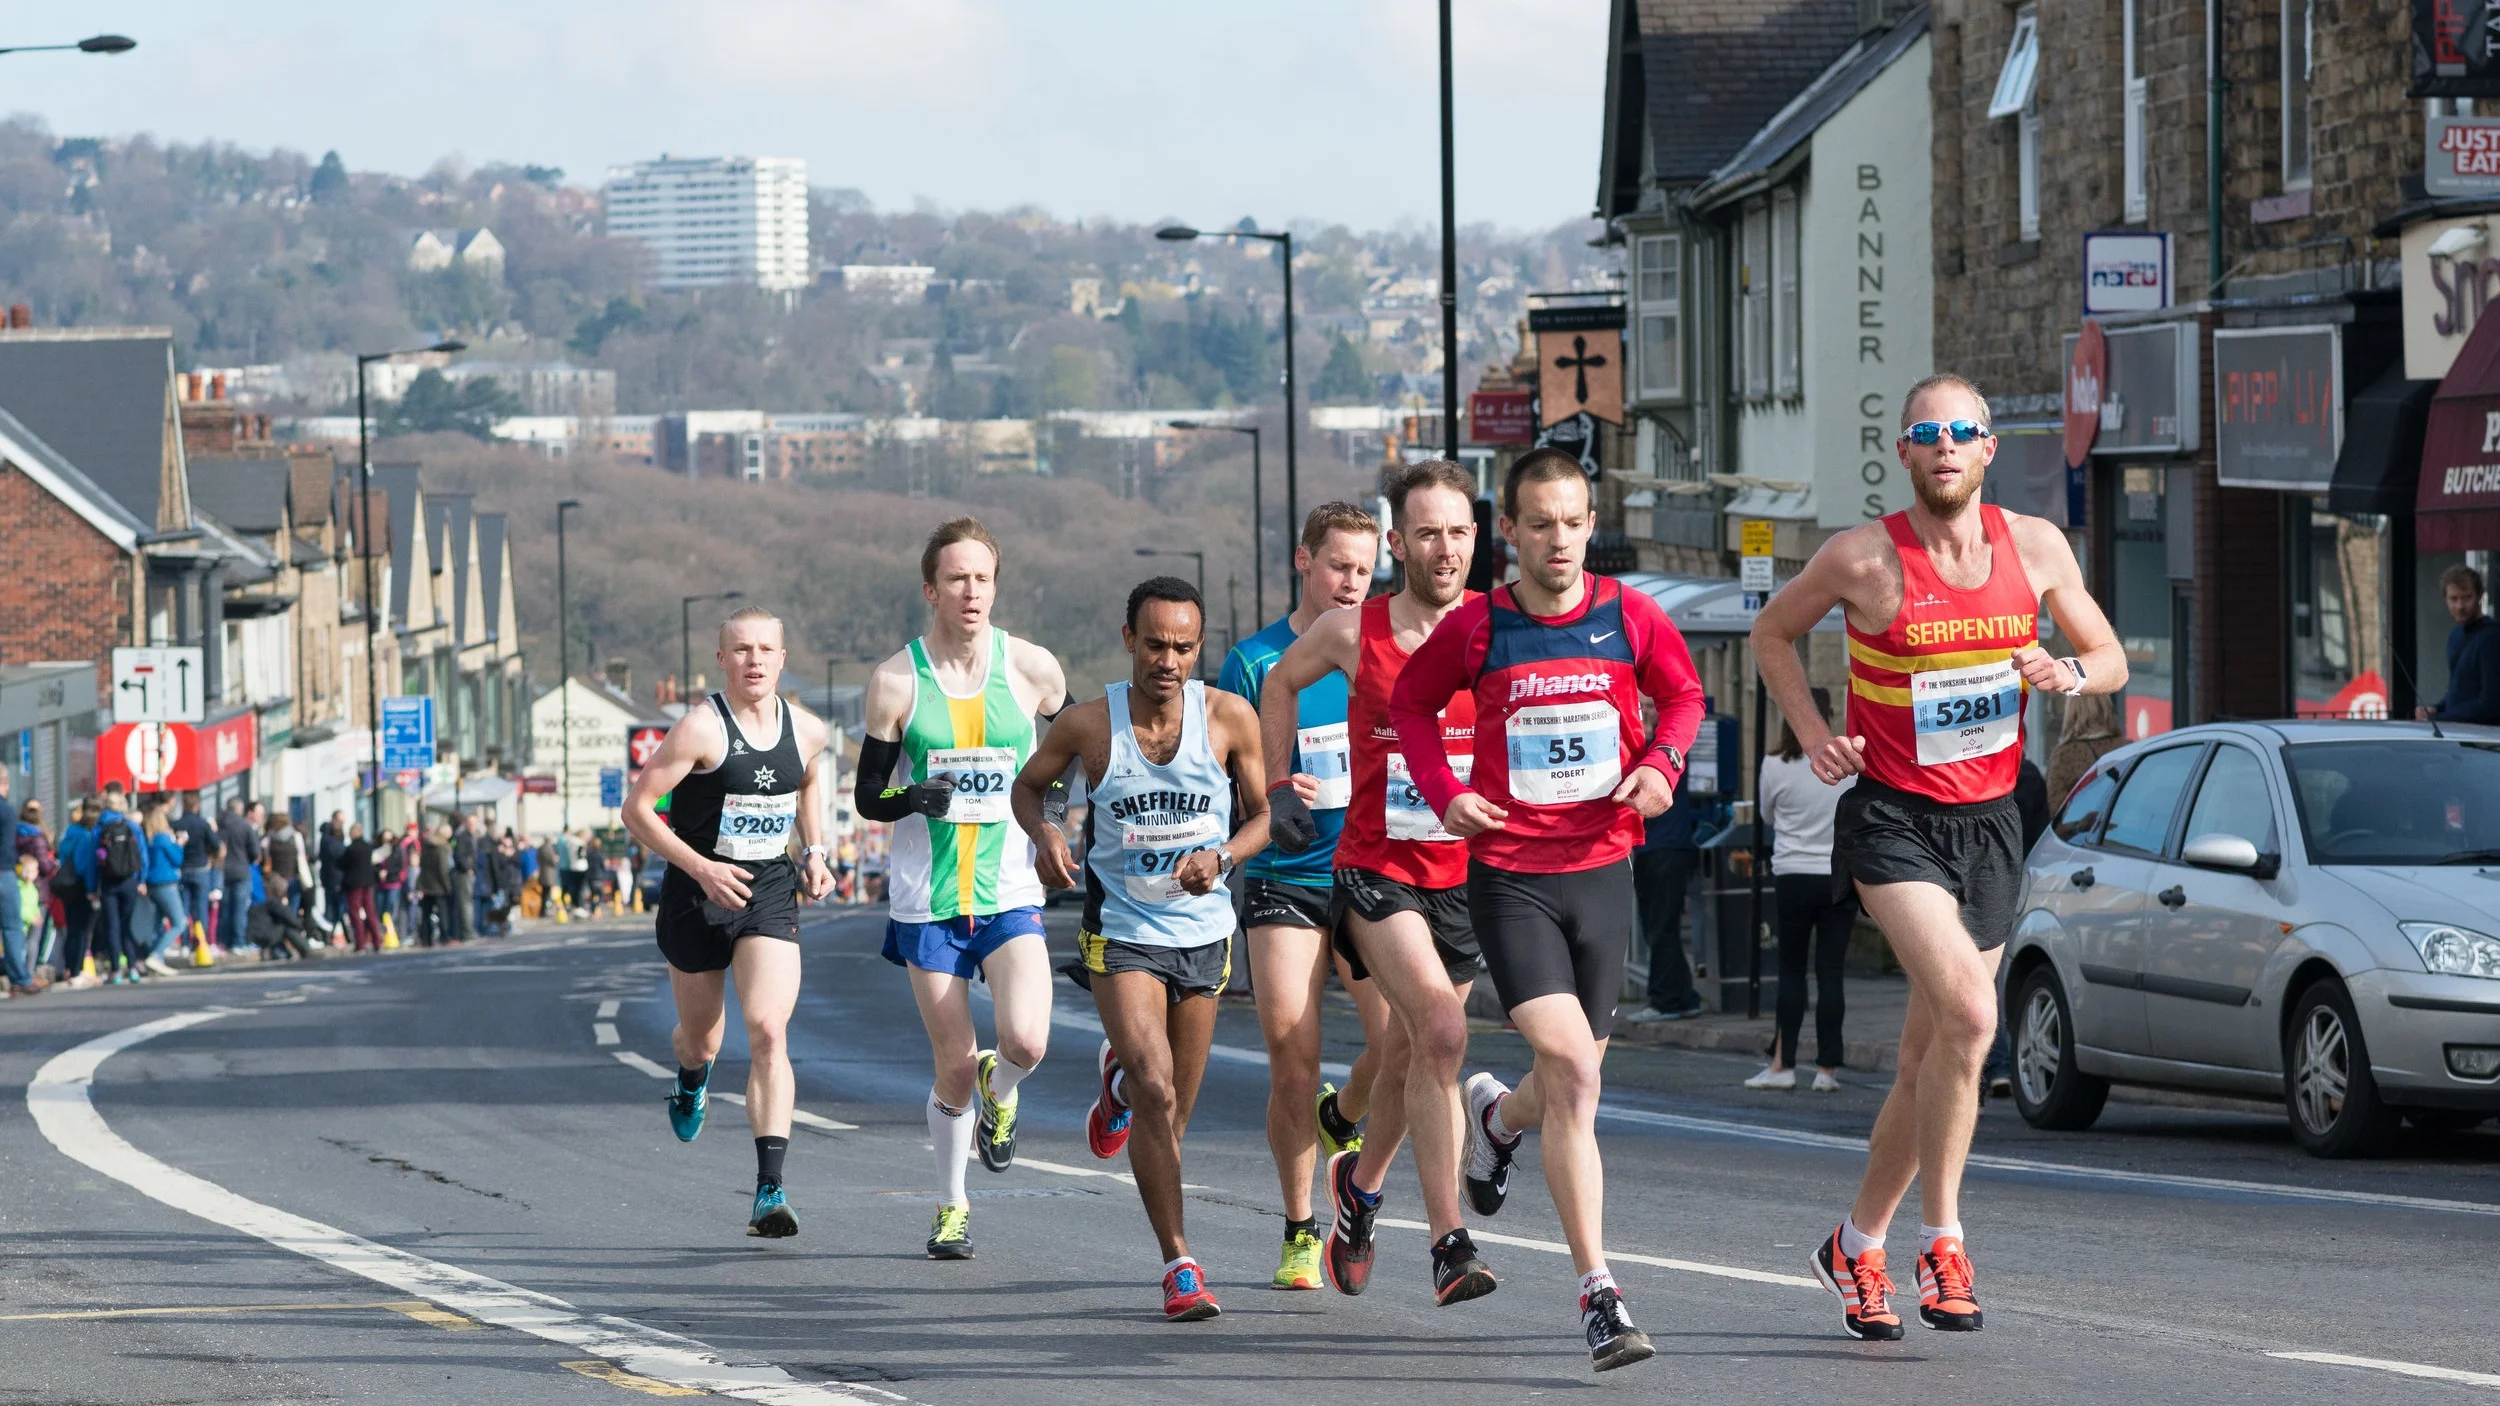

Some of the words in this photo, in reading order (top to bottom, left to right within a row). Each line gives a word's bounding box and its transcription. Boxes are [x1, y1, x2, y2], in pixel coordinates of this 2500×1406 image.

[1857, 165, 1884, 363] BANNER
[1905, 614, 2034, 647] SERPENTINE
[1509, 673, 1615, 702] phanos
[1929, 681, 1937, 689] THE
[1939, 677, 1968, 689] YORKSHIRE
[1968, 675, 1994, 685] MARATHON
[1936, 692, 2002, 727] 5281
[1522, 717, 1532, 726] THE
[1533, 716, 1561, 726] YORKSHIRE
[1563, 714, 1590, 724] MARATHON
[1960, 725, 1985, 738] JOHN
[1312, 736, 1321, 744] THE
[1548, 737, 1586, 764] 55
[1551, 769, 1586, 779] ROBERT
[1110, 791, 1211, 820] SHEFFIELD
[733, 815, 786, 834] 9203
[1135, 811, 1189, 827] RUNNING
[1137, 834, 1145, 842] THE
[1145, 833, 1171, 842] YORKSHIRE
[1172, 830, 1196, 840] MARATHON
[1254, 908, 1288, 919] SCOTT
